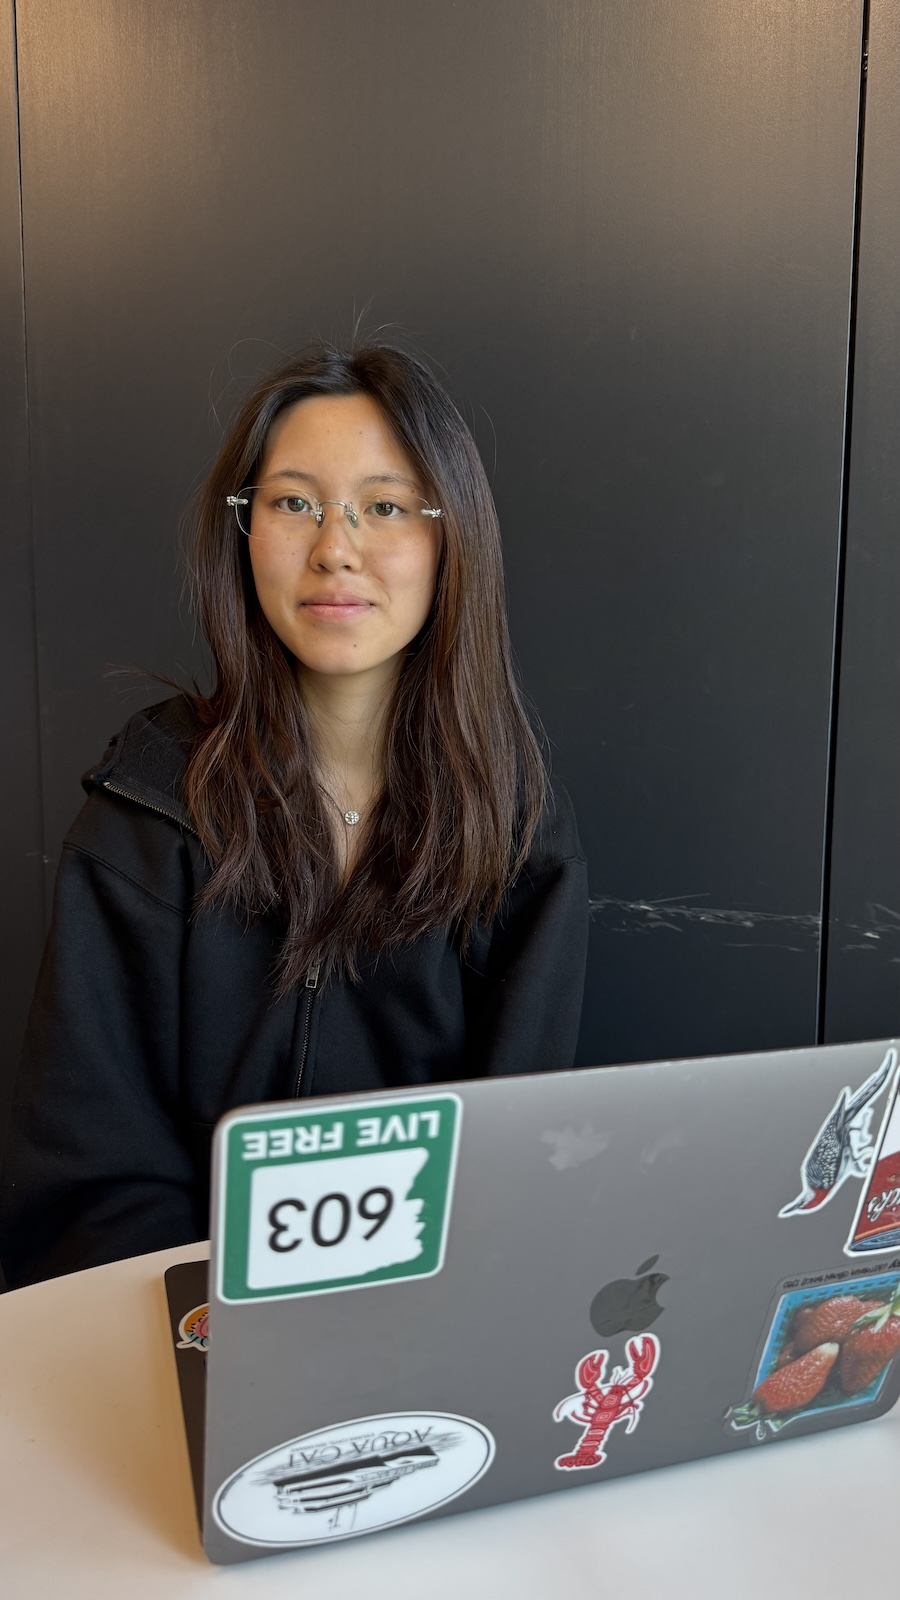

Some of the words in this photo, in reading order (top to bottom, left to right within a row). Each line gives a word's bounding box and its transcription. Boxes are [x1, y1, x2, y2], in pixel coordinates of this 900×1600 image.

[241, 1121, 345, 1161] FREE
[356, 1110, 441, 1147] LIVE
[267, 1186, 394, 1253] 603
[283, 1446, 341, 1467] CAT
[352, 1426, 432, 1454] AQUA
